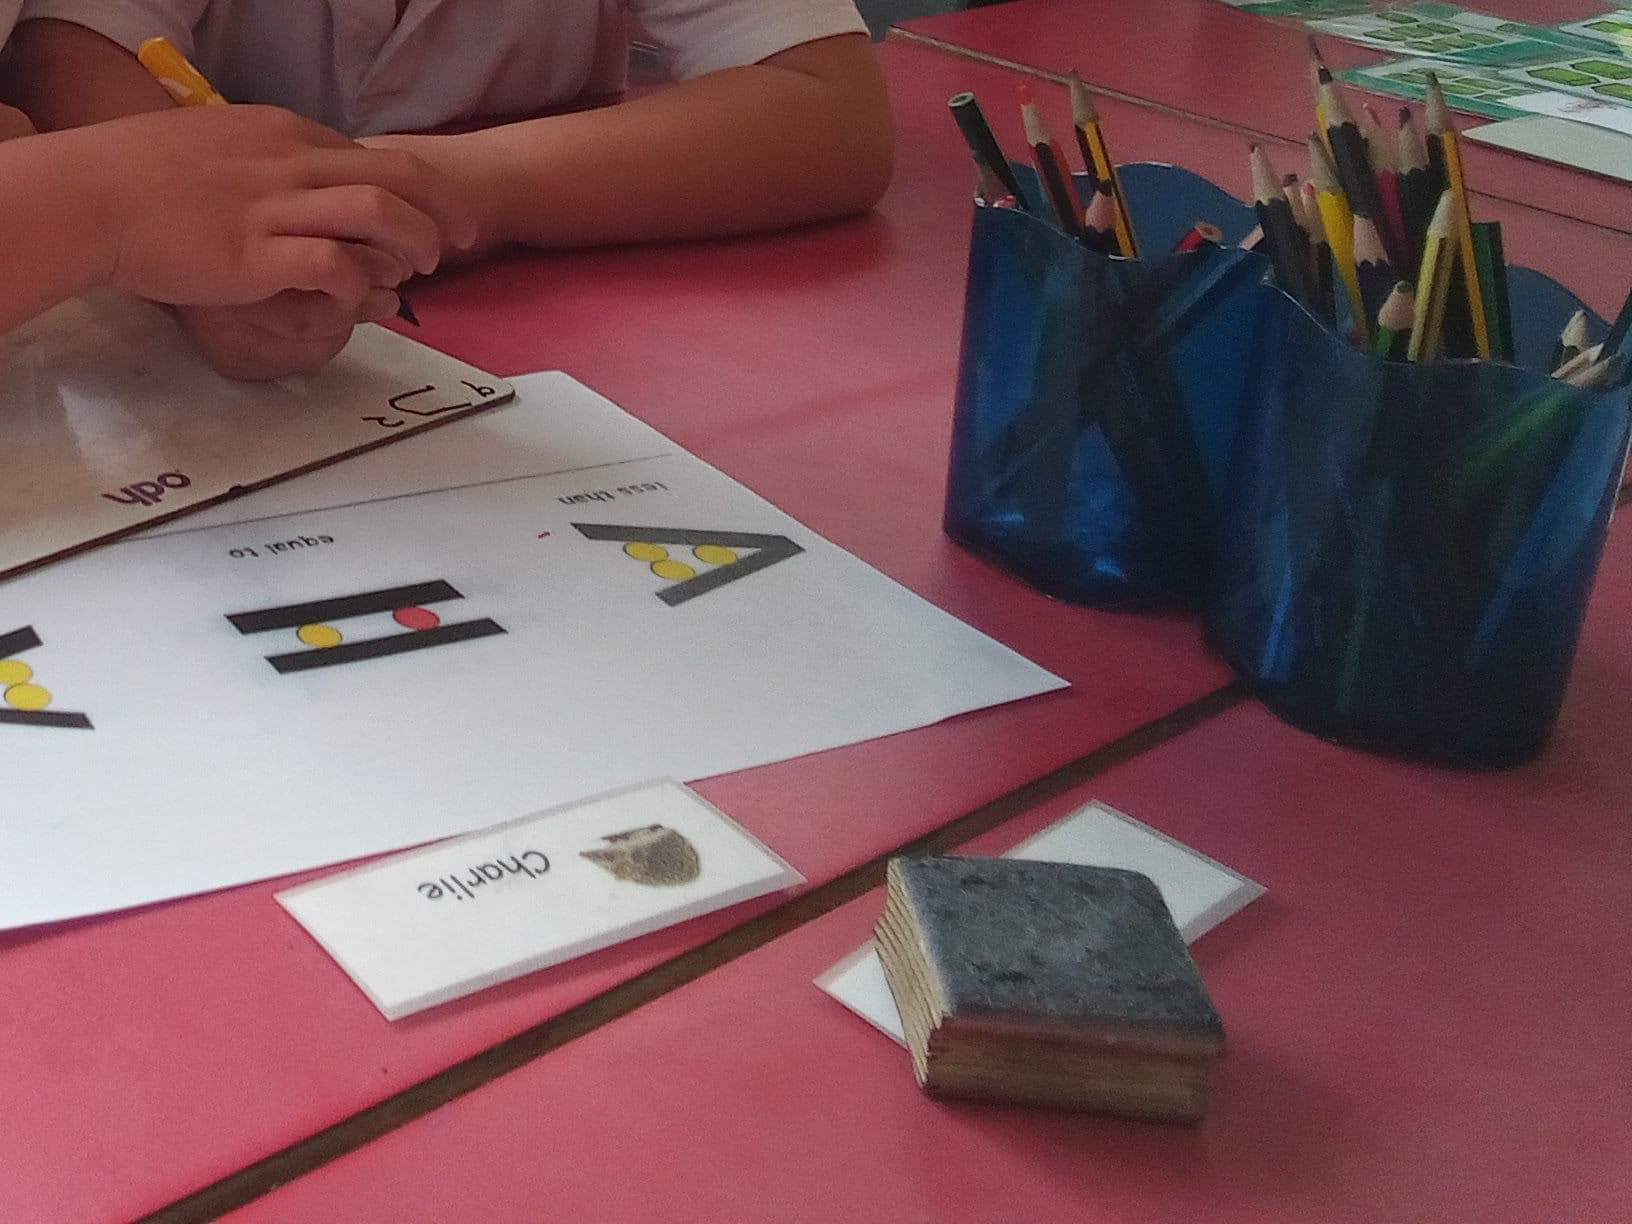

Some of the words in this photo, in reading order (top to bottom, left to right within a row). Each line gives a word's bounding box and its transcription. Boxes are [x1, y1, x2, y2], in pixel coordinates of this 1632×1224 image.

[617, 481, 668, 495] less
[558, 491, 615, 504] than
[264, 535, 334, 555] equal
[229, 547, 259, 558] to
[418, 851, 550, 900] Charlie
